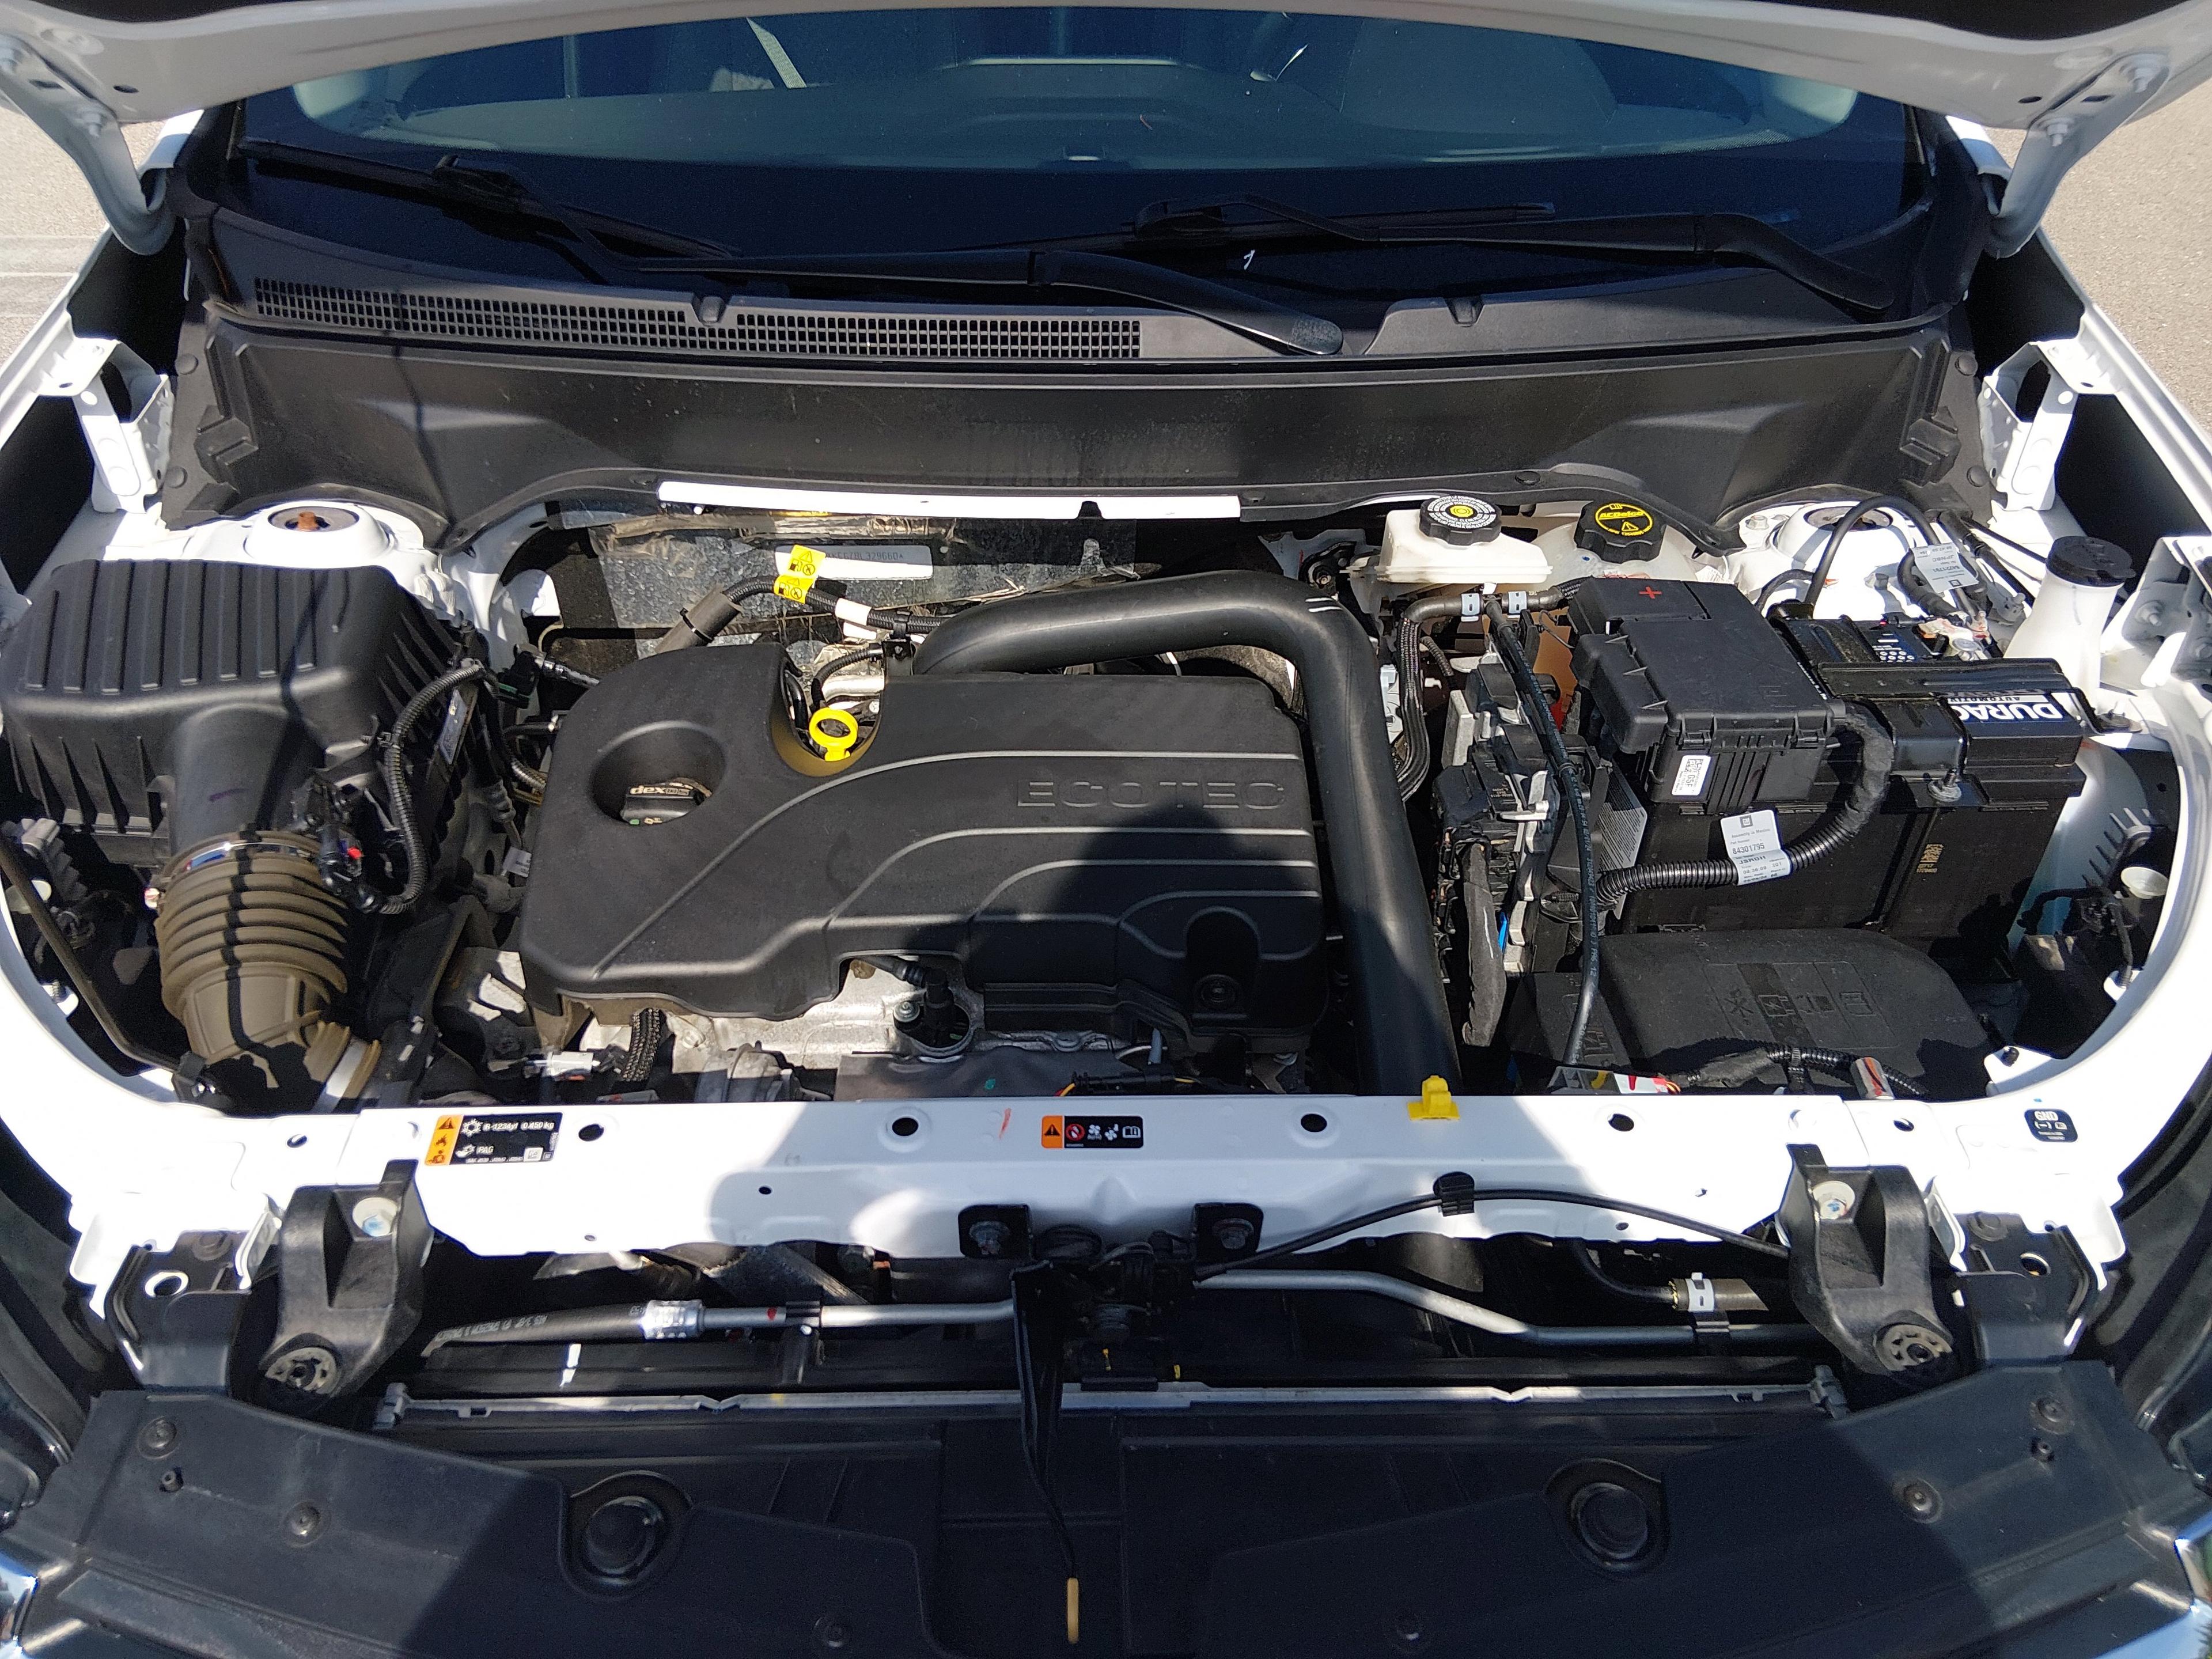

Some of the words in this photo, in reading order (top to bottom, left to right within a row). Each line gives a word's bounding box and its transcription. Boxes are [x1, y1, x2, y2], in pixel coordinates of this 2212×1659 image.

[1950, 703, 2063, 720] DURAC
[630, 785, 691, 796] dexos
[1017, 781, 1285, 809] ECOTEC
[1732, 842, 1765, 855] 84301795
[543, 1121, 555, 1131] kg
[476, 1145, 494, 1154] PAG
